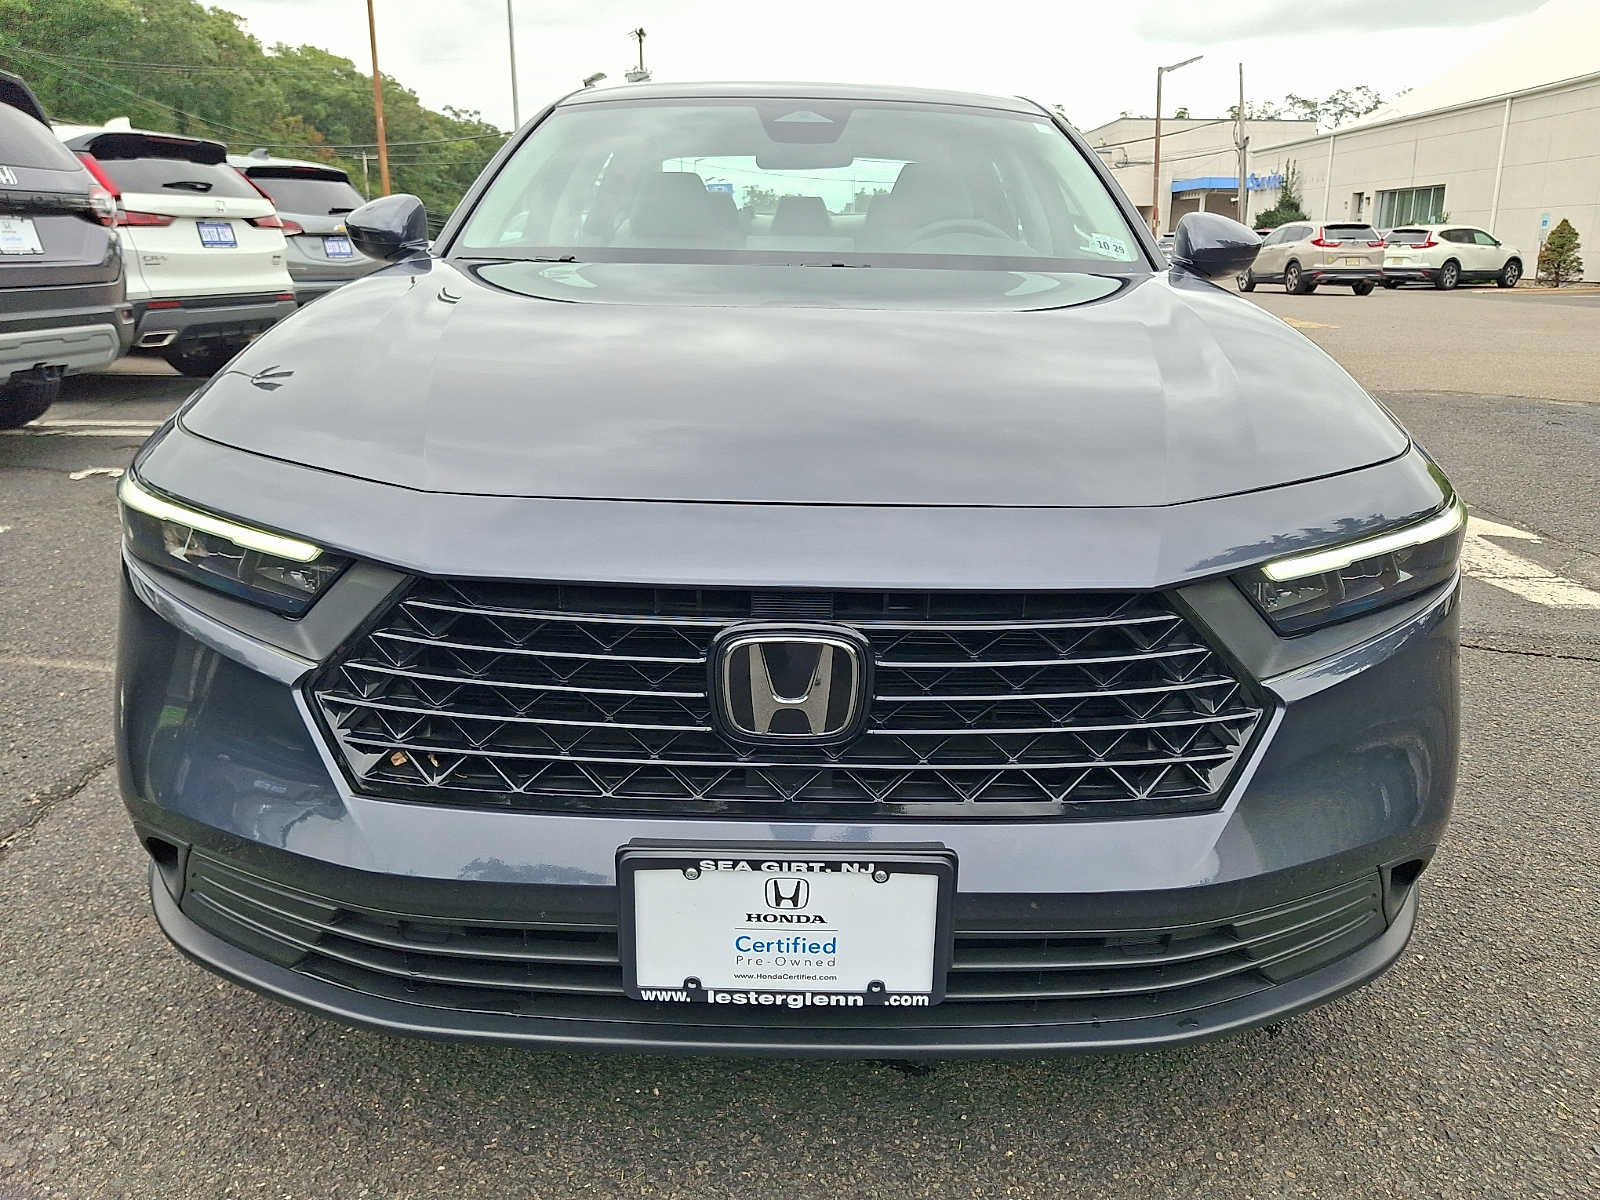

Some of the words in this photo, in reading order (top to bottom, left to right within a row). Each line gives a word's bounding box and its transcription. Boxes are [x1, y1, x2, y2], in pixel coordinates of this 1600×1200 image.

[1096, 240, 1110, 251] 10
[699, 860, 752, 872] SEA
[841, 863, 875, 873] NJ
[745, 913, 828, 924] HONDA
[735, 936, 837, 954] Certified
[736, 955, 836, 967] Pre-Owned
[733, 973, 838, 981] www.HondaCertified.com
[640, 990, 691, 1003] www.
[707, 990, 864, 1009] lesterglenn
[884, 994, 929, 1006] .com
